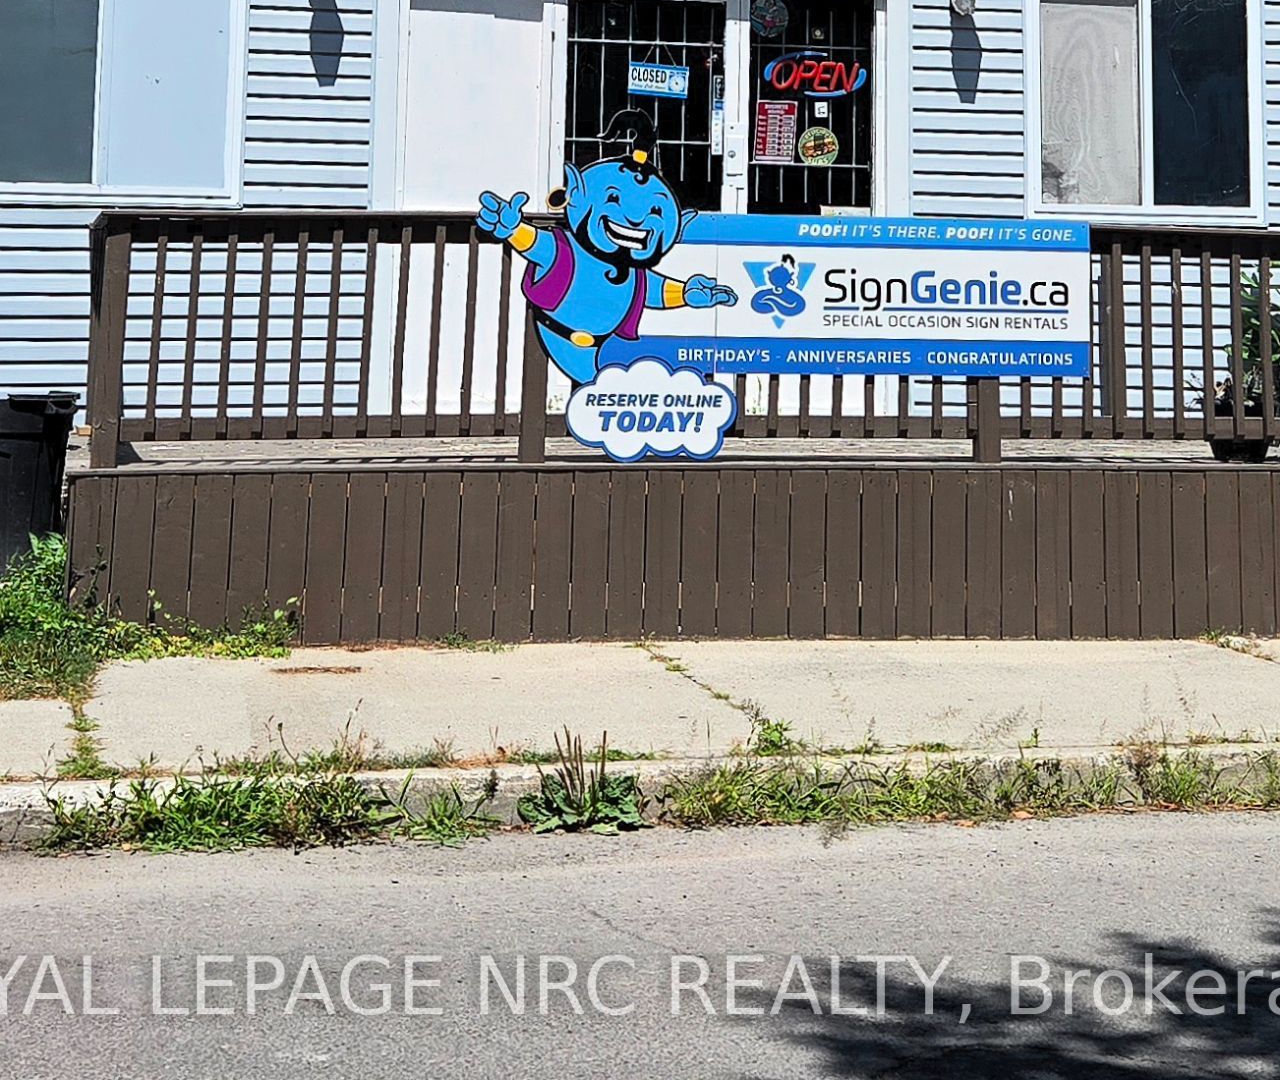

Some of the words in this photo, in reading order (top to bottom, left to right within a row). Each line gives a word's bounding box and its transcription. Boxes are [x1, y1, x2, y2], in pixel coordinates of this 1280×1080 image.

[631, 67, 667, 84] CLOSED
[772, 60, 860, 93] OPEN
[799, 224, 848, 237] POOF!
[852, 224, 881, 238] IT'S
[888, 226, 940, 239] THERE.
[946, 228, 993, 240] POOF!
[998, 229, 1026, 241] IT'S
[1032, 229, 1076, 242] GONE.
[824, 269, 1069, 311] SignGenie.ca
[823, 314, 883, 327] SPECIAL
[888, 315, 962, 328] OCCASION
[966, 316, 999, 329] SIGN
[1004, 317, 1068, 330] RENTALS
[678, 348, 770, 361] BIRTHDAY'S
[786, 350, 911, 364] ANNIVERSARIES
[927, 352, 1073, 365] CONGRATULATIONS
[586, 393, 659, 407] RESERVE
[663, 394, 723, 408] ONLINE
[599, 411, 704, 433] TODAY!
